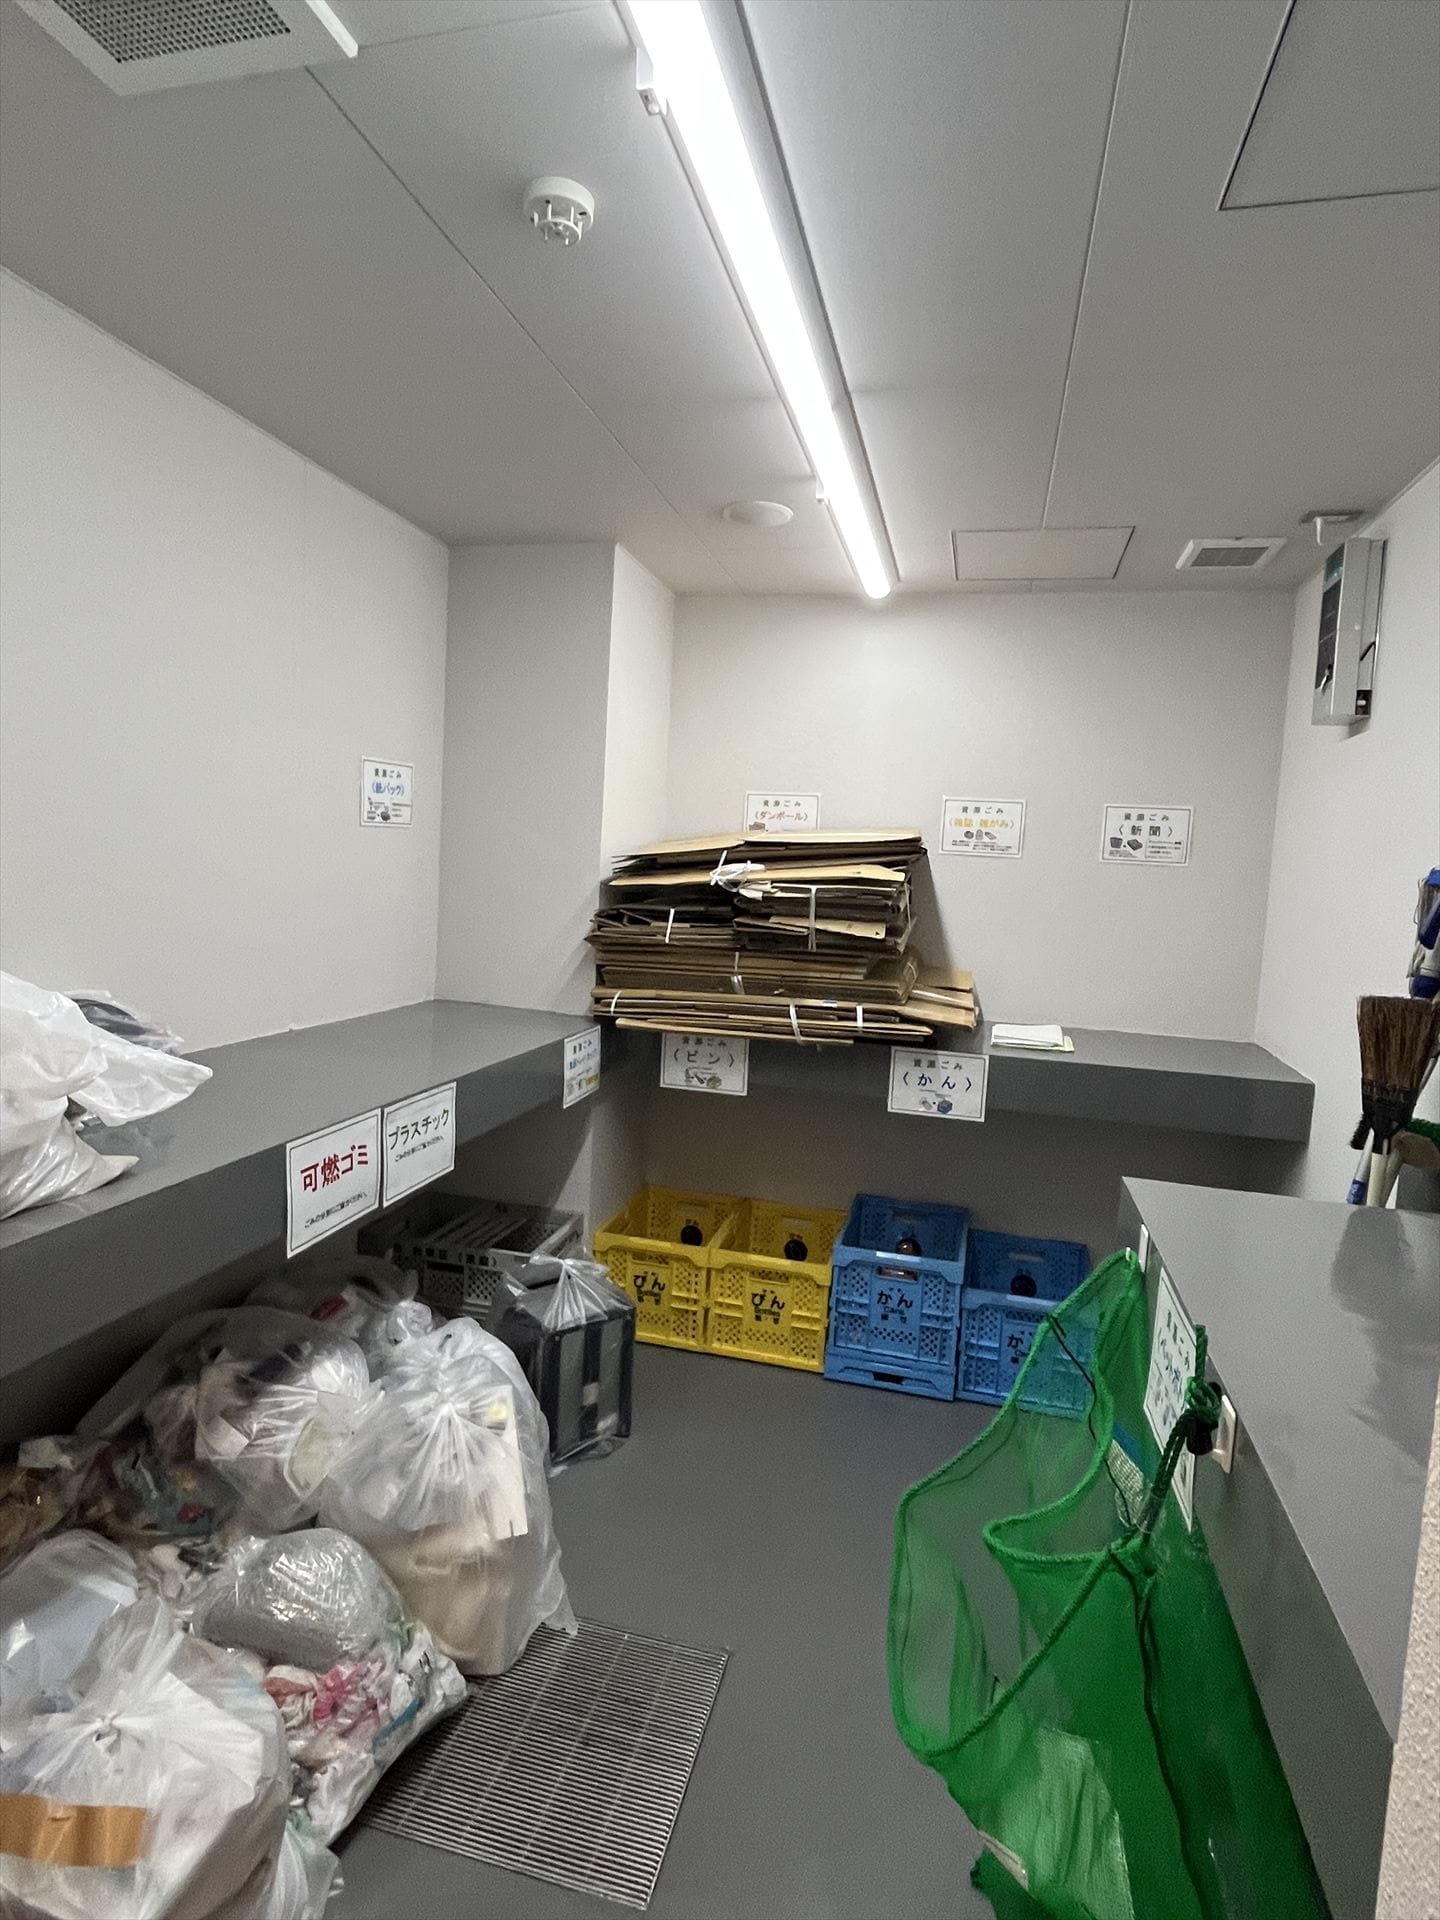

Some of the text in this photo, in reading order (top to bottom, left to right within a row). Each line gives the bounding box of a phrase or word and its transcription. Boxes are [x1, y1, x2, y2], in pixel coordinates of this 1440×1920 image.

[388, 1107, 450, 1151] プラスチック
[299, 1143, 369, 1193] 可燃ゴミ
[876, 1289, 914, 1309] かん
